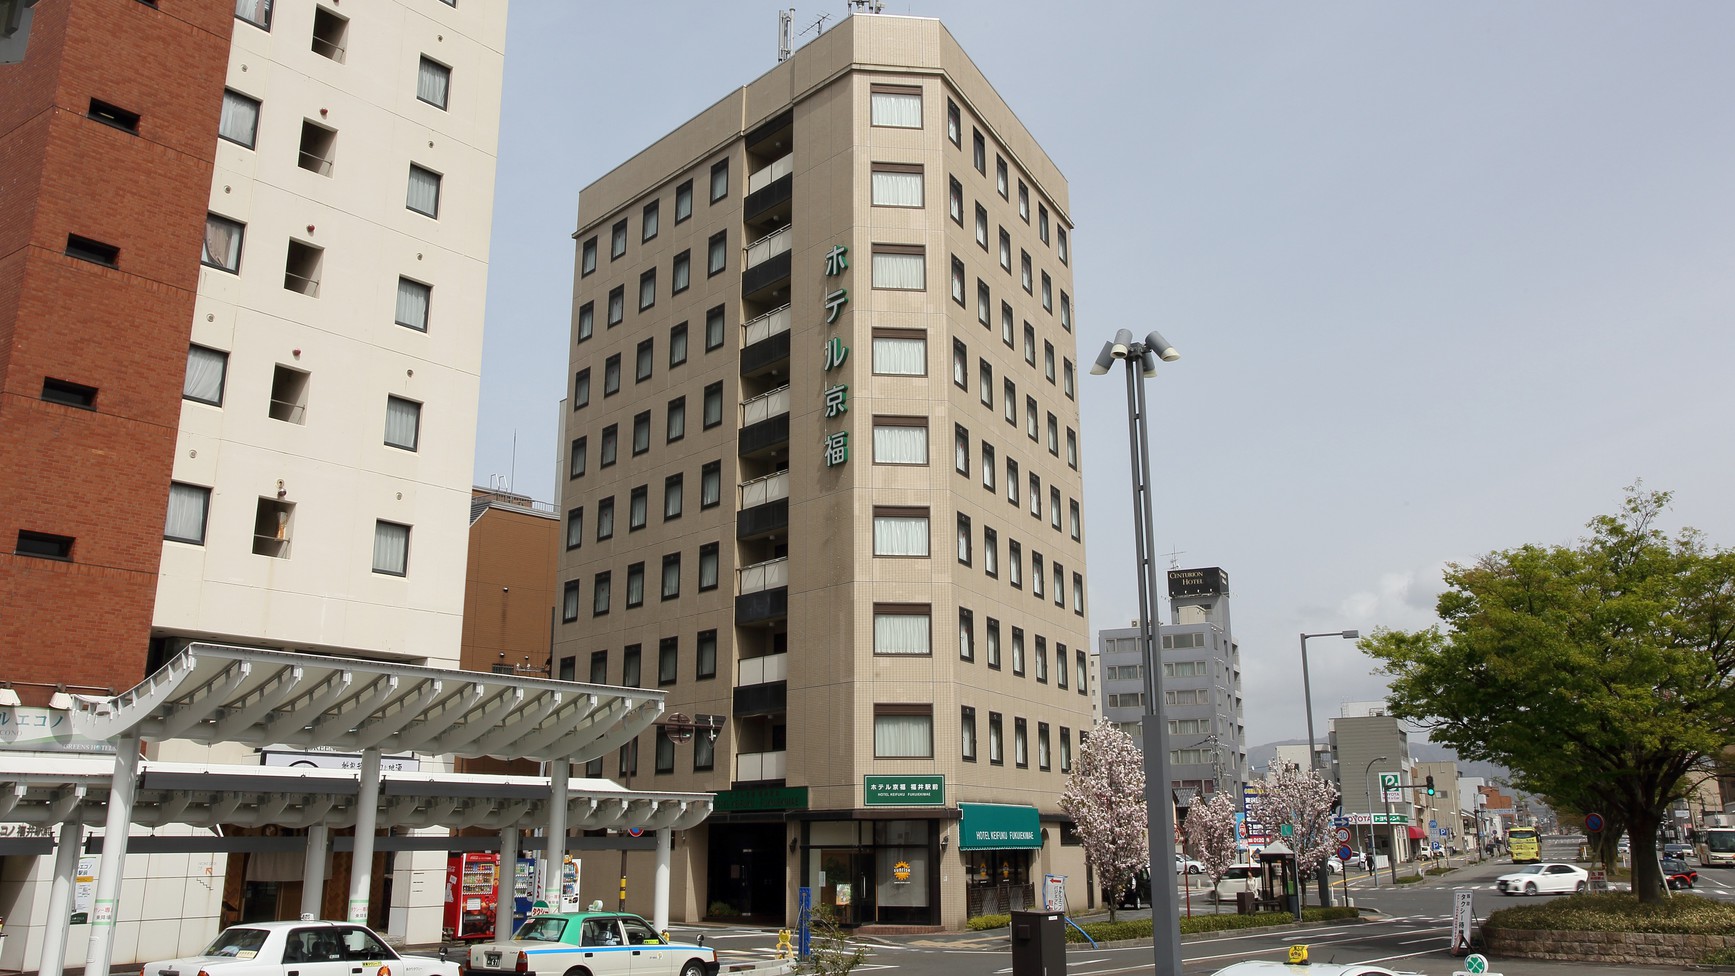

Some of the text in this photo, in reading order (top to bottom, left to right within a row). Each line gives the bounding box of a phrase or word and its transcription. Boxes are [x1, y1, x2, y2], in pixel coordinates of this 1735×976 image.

[825, 245, 849, 468] ホテル京福
[870, 783, 939, 791] ホテル京福 福井駅前
[976, 831, 990, 840] HOTEL
[990, 831, 1008, 840] KEIFUKU
[532, 907, 549, 916] タクシー
